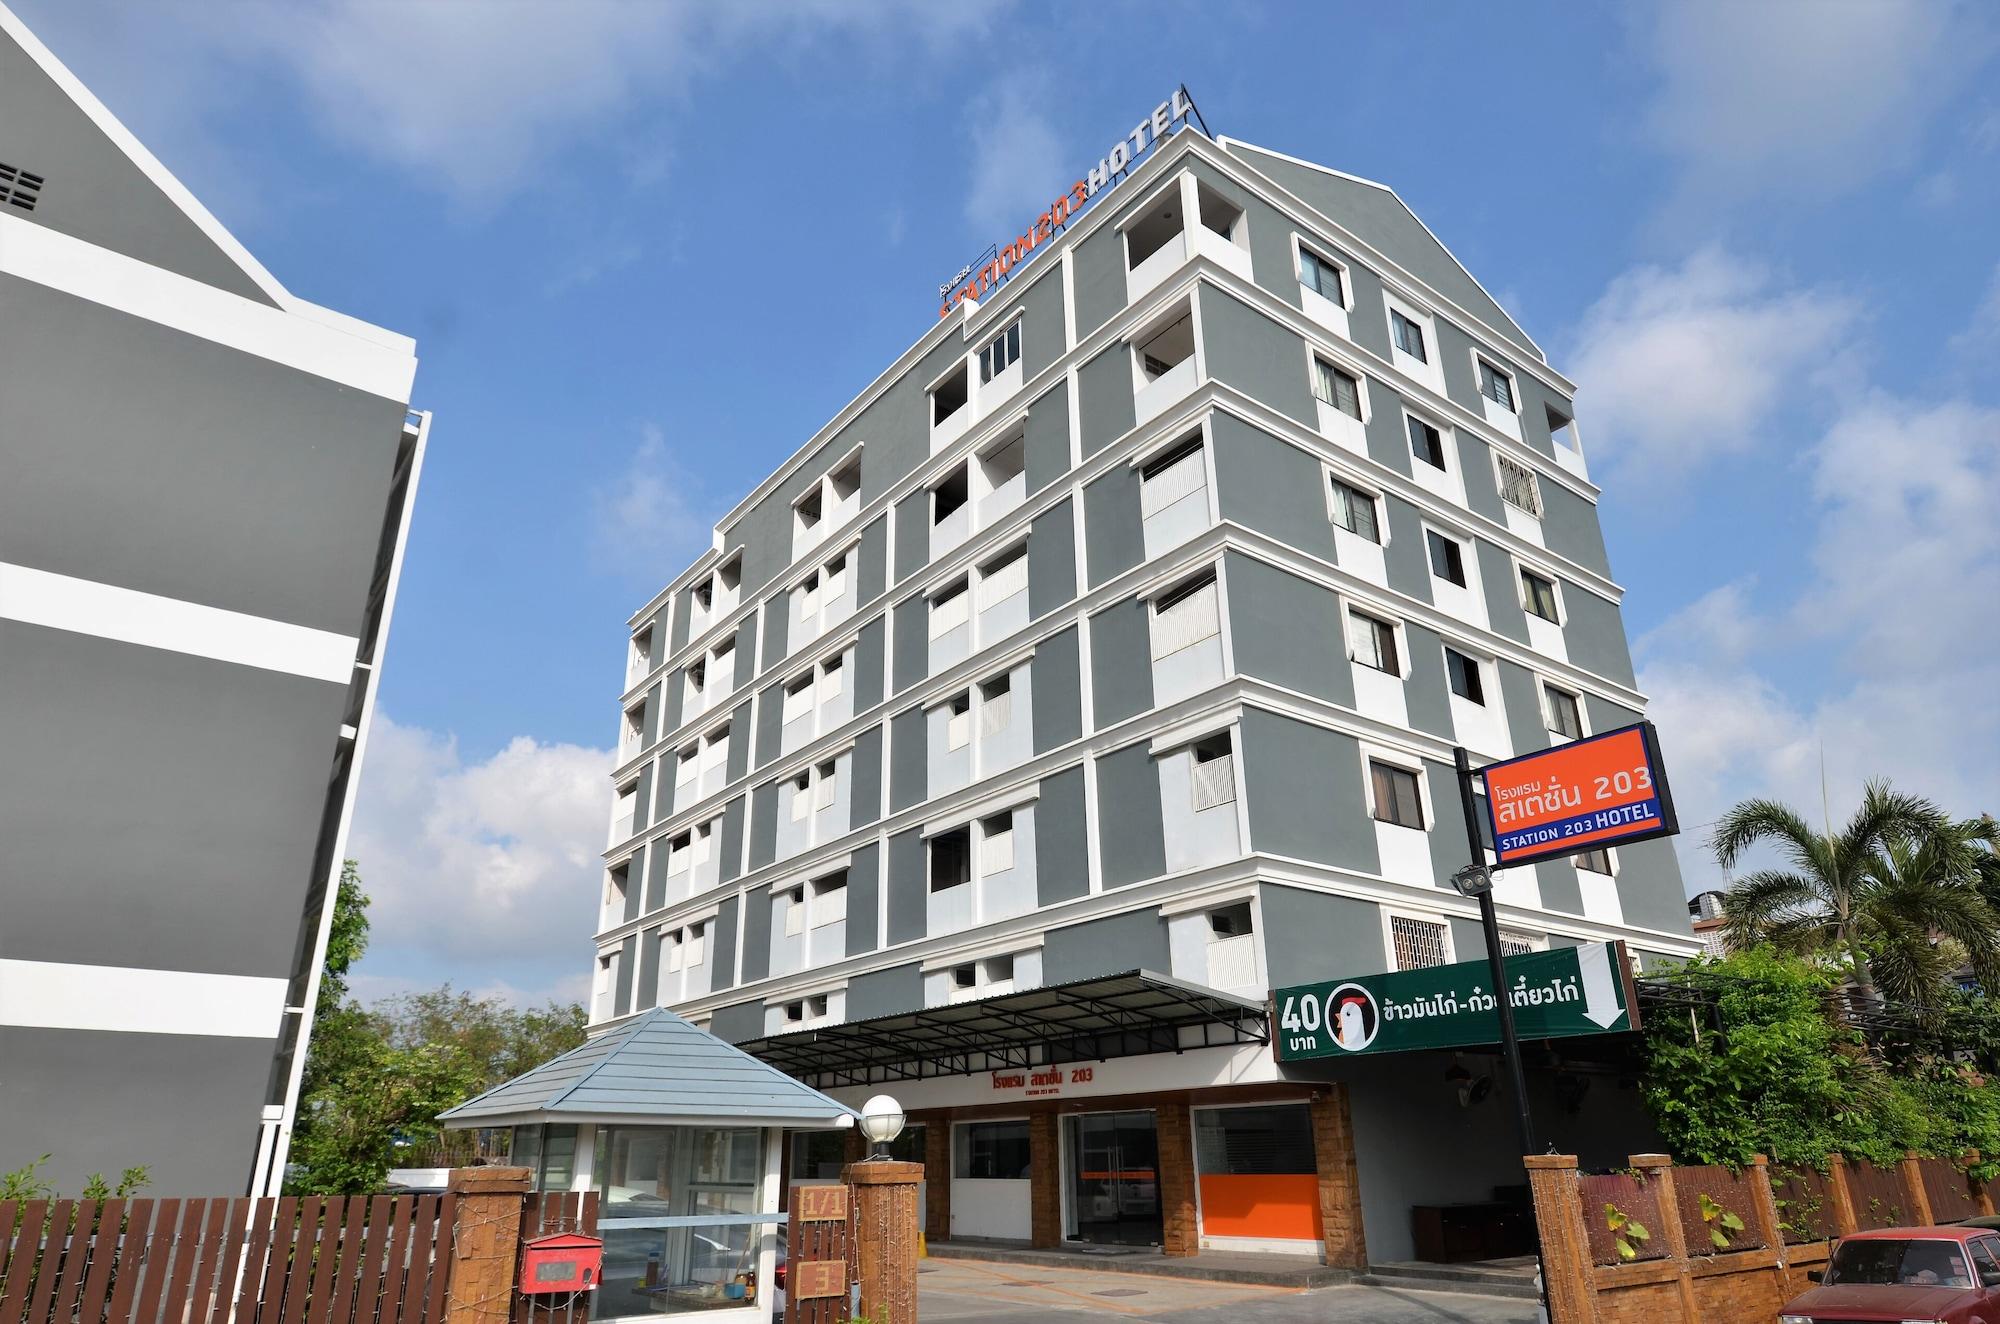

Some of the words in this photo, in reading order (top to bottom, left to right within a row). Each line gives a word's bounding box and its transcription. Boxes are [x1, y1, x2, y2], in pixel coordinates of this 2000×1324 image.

[1088, 90, 1192, 196] HOTEL
[1494, 780, 1541, 802] โรงแรม
[1498, 775, 1582, 824] สเตชั่น
[1593, 766, 1652, 801] 203
[1502, 827, 1559, 850] STATION
[1565, 819, 1593, 836] 203
[1595, 803, 1655, 829] HOTEL
[1280, 993, 1321, 1033] 40
[1382, 975, 1579, 1022] ข้าวมันไก่-ก๋วเตี๋ยวไก่
[1289, 1034, 1317, 1052] บาท
[1071, 1067, 1093, 1083] 203
[806, 1191, 842, 1215] 1/1
[816, 1266, 829, 1293] 3
